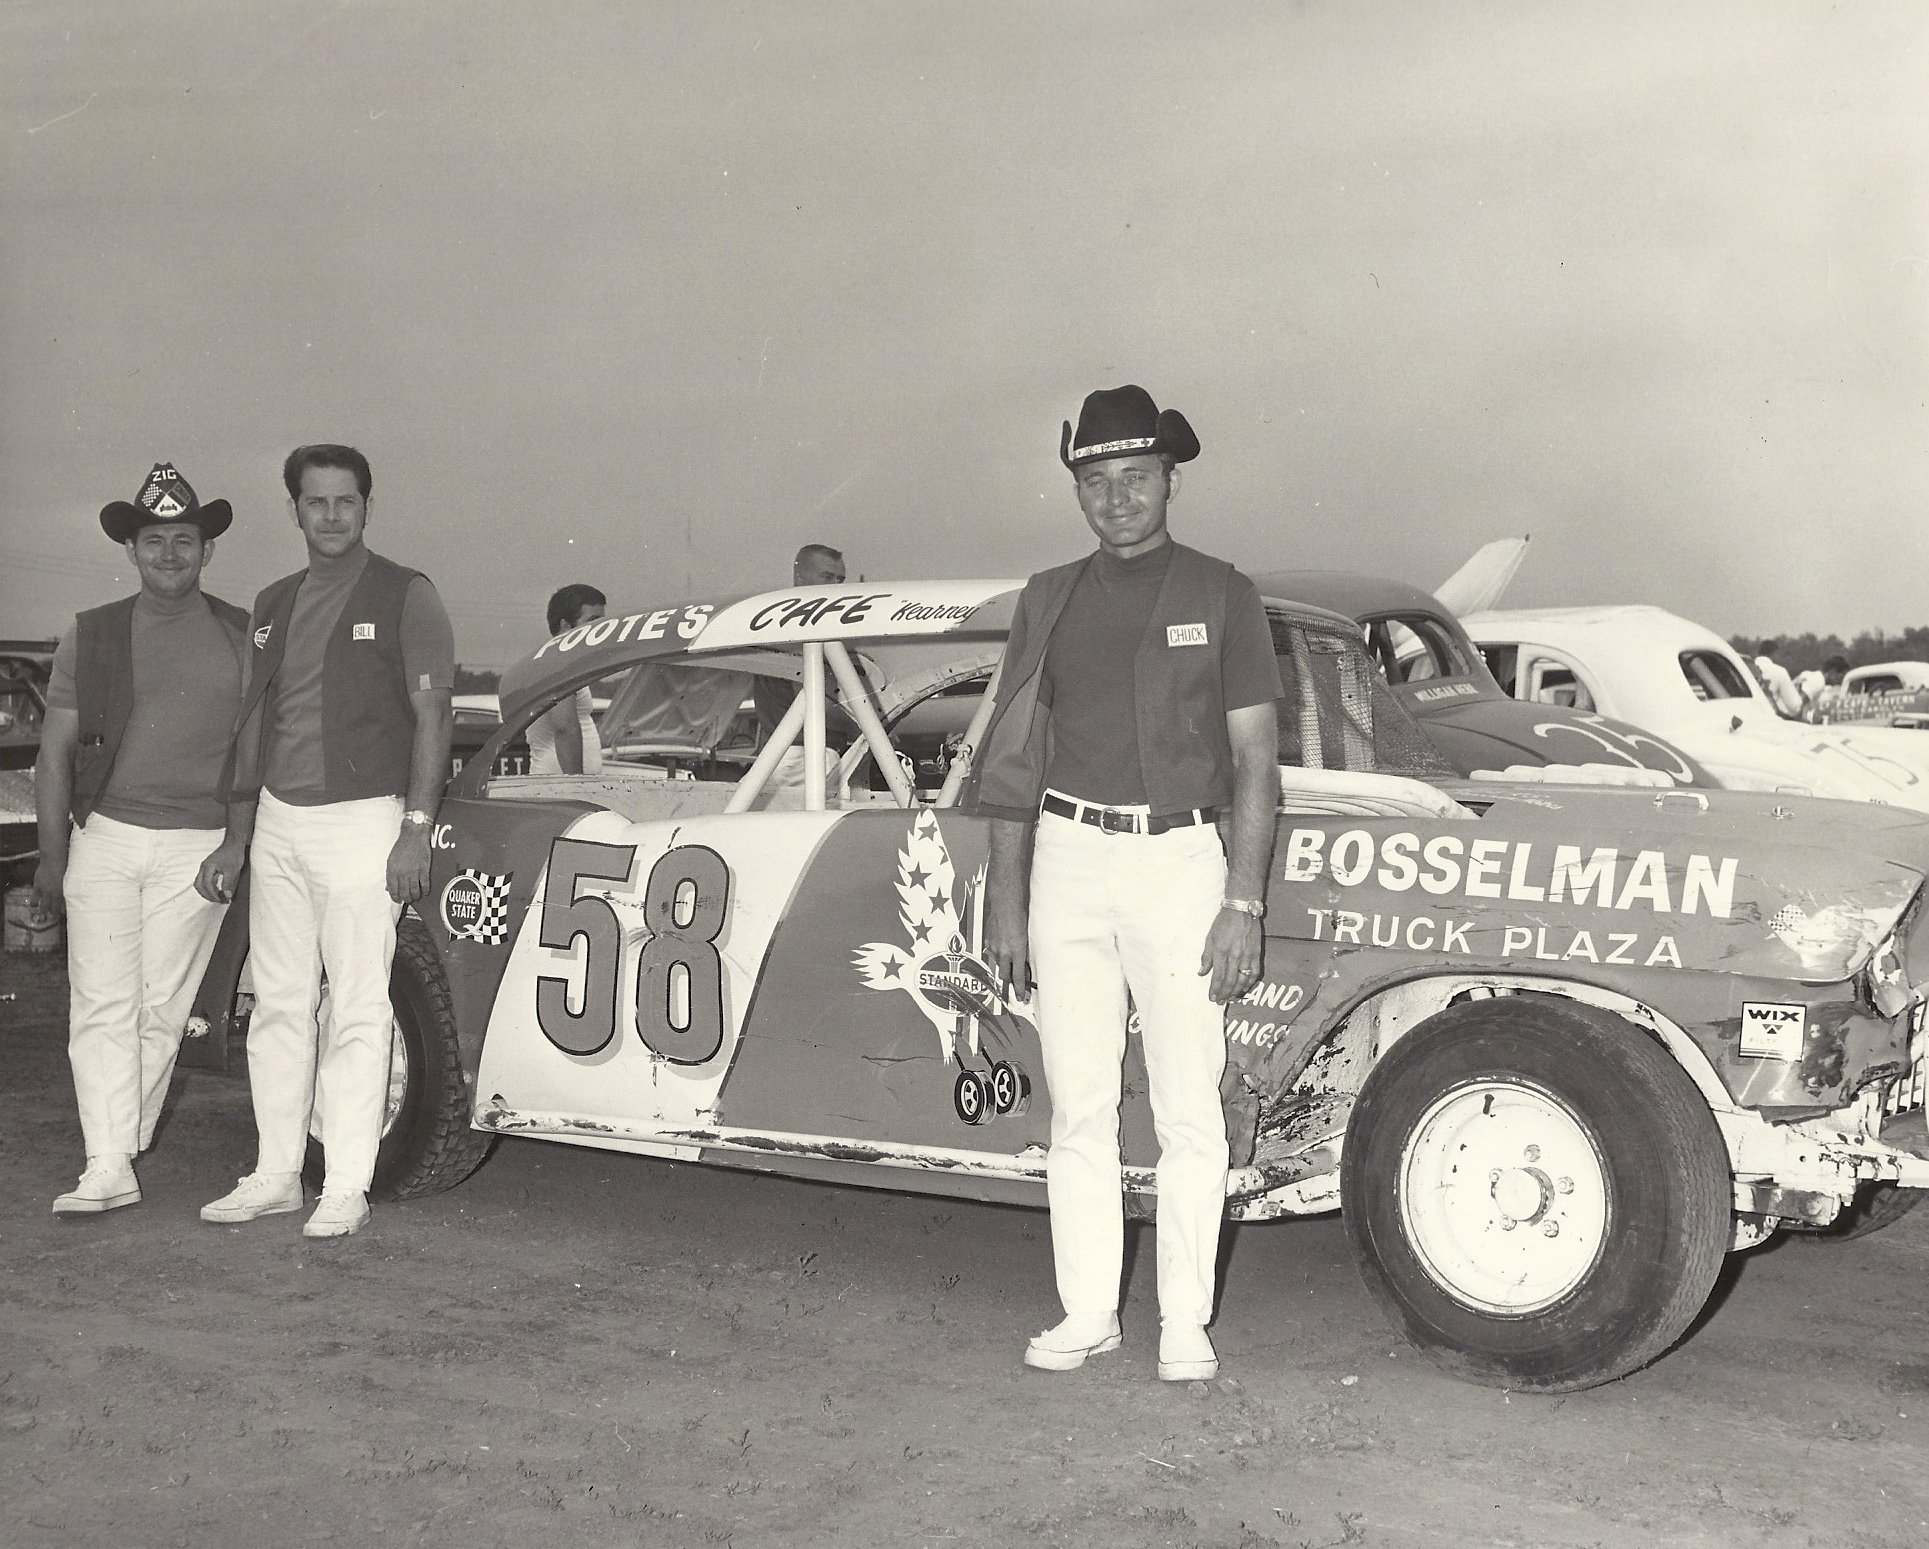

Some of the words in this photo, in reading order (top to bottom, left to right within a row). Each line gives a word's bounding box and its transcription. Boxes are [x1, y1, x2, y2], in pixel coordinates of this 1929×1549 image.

[152, 469, 177, 482] ZIG
[750, 594, 893, 632] CAFE
[354, 624, 374, 639] BILL
[1170, 627, 1205, 644] CHUCK
[430, 823, 456, 850] NC.
[1284, 829, 1739, 919] BOSSELMAN
[448, 889, 481, 906] QUAKER
[451, 903, 476, 919] STATE
[1307, 908, 1476, 954] TRUCK
[1502, 926, 1684, 969] PLAZA
[536, 836, 731, 1066] 58
[1748, 1009, 1801, 1022] WIX
